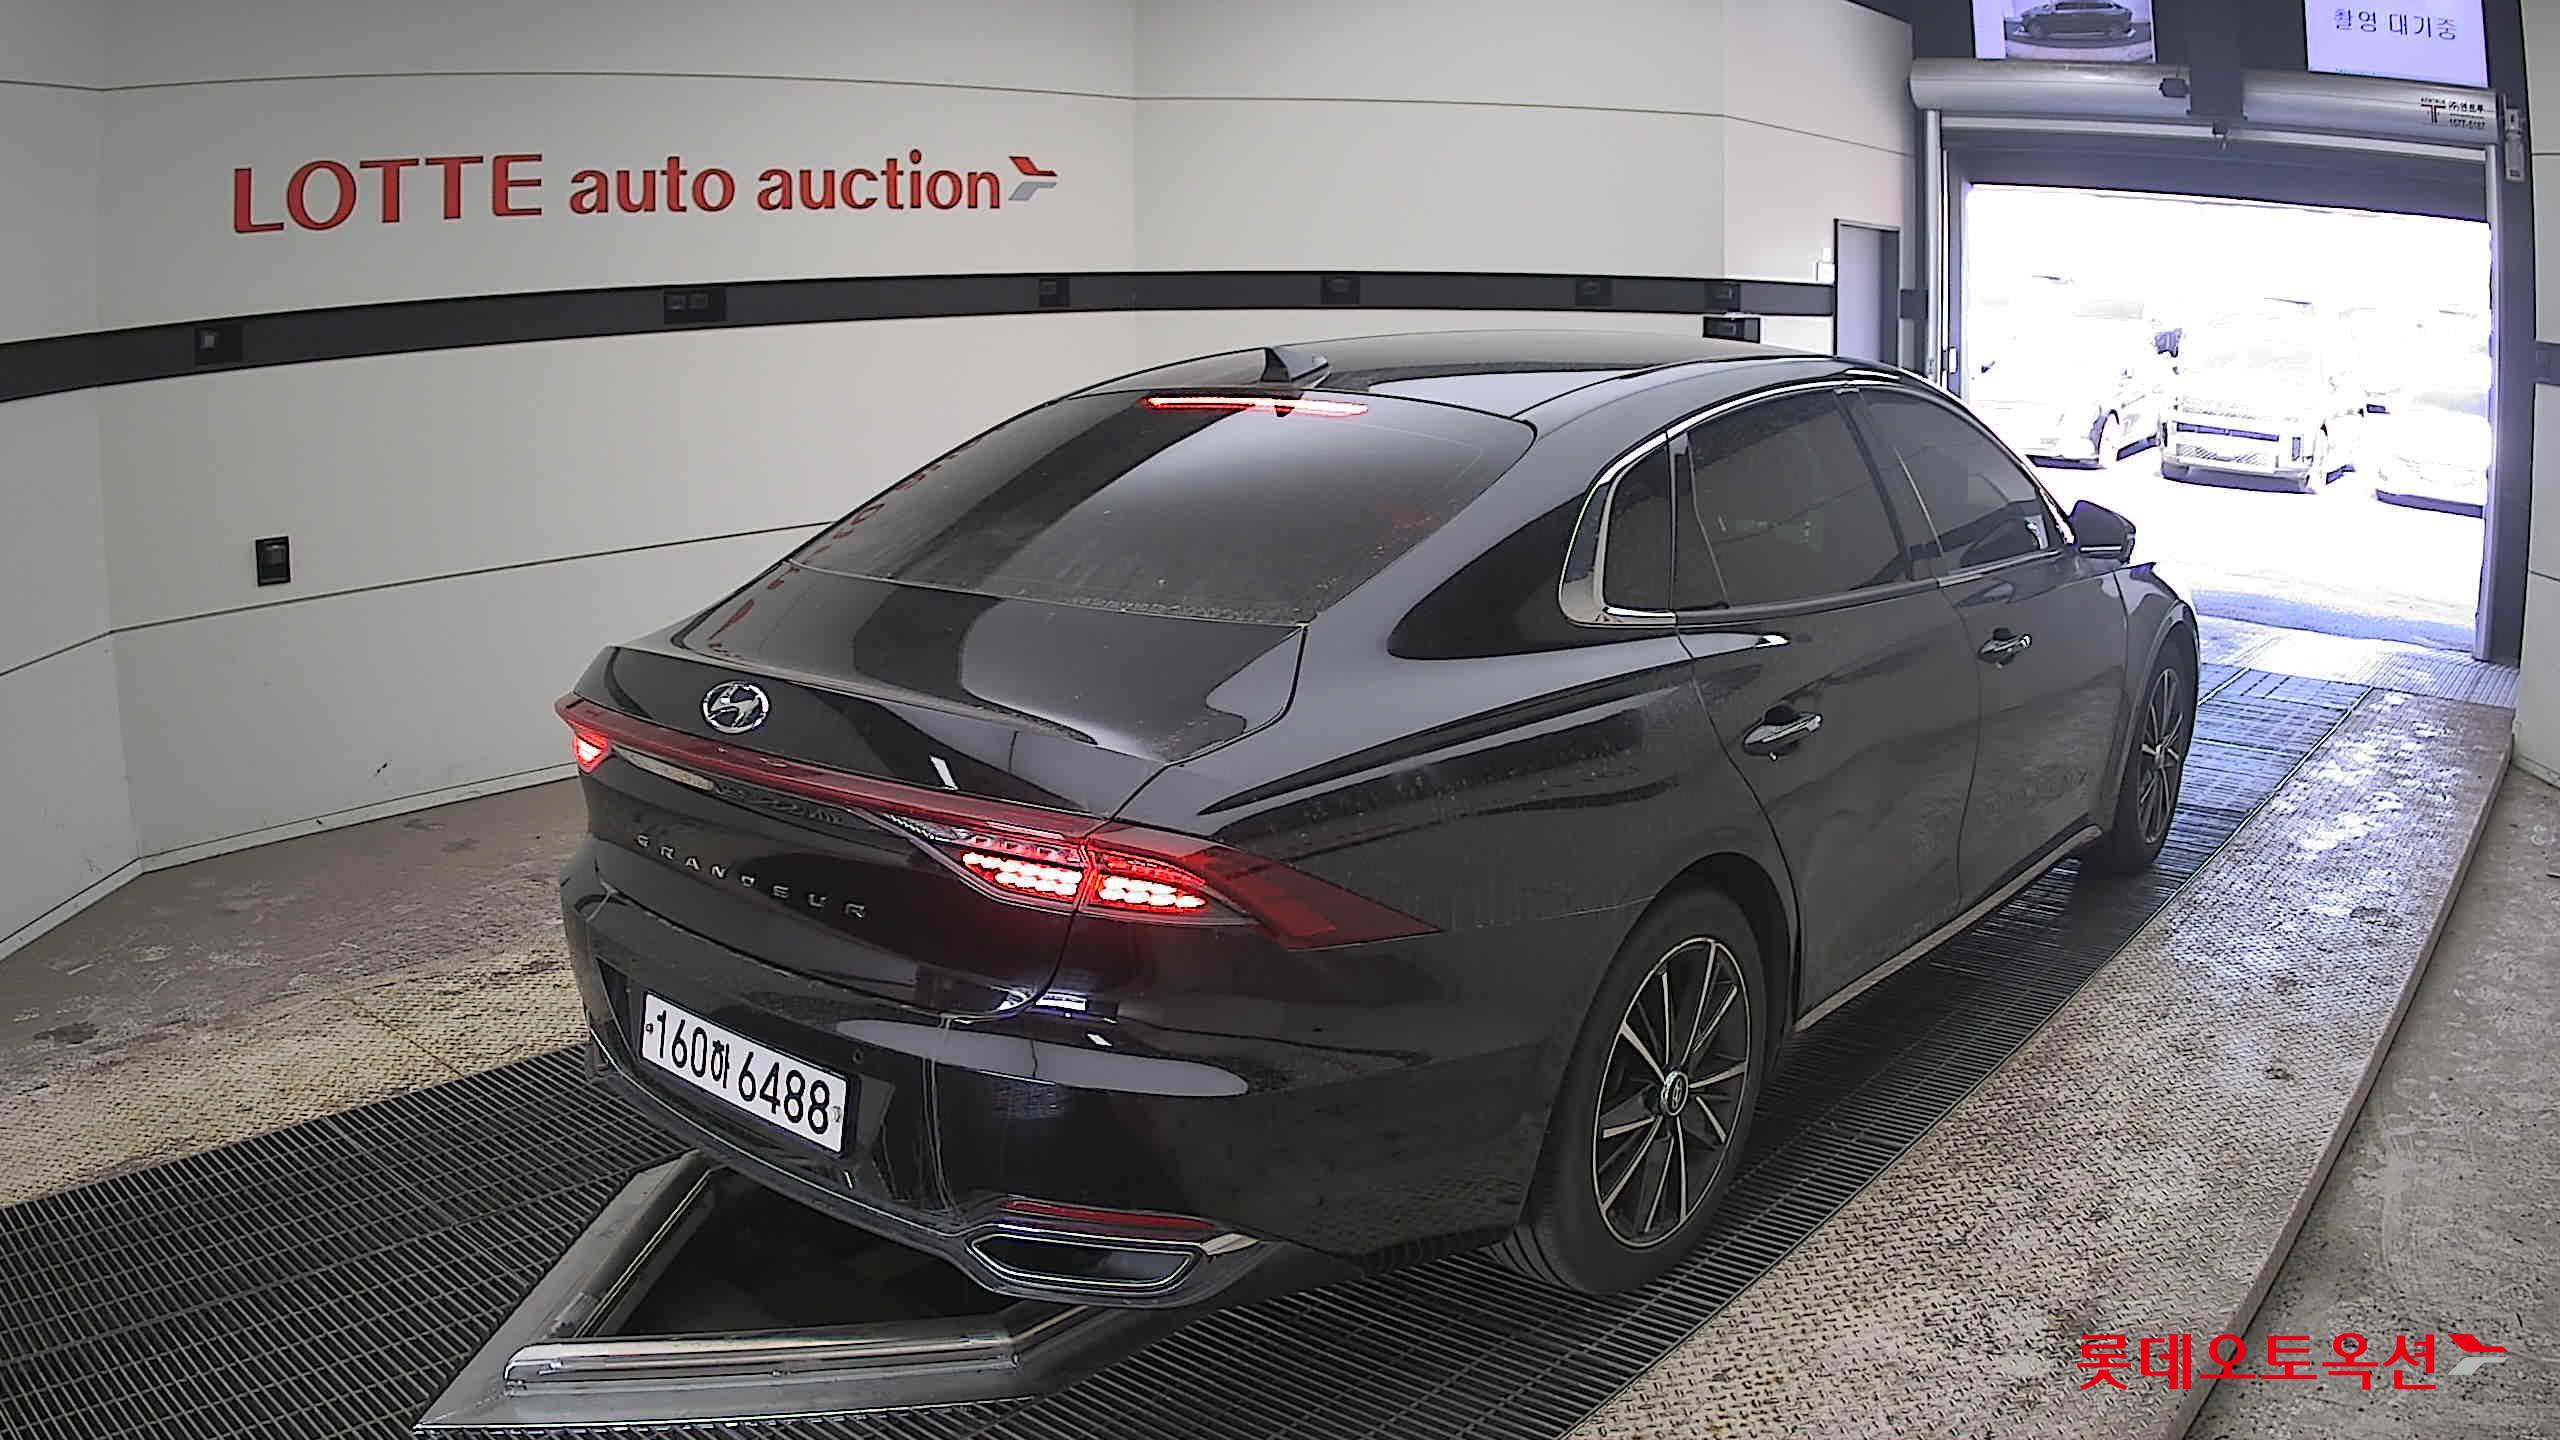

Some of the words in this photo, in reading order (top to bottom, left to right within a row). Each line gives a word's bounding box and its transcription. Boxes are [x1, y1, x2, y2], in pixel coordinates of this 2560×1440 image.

[2389, 13, 2457, 41] 대기중
[234, 153, 543, 234] LOTTE
[569, 155, 736, 215] auto
[756, 148, 1001, 211] auction
[635, 833, 867, 920] GRANDEUR
[656, 1010, 730, 1089] 160하
[738, 1051, 831, 1135] 6488
